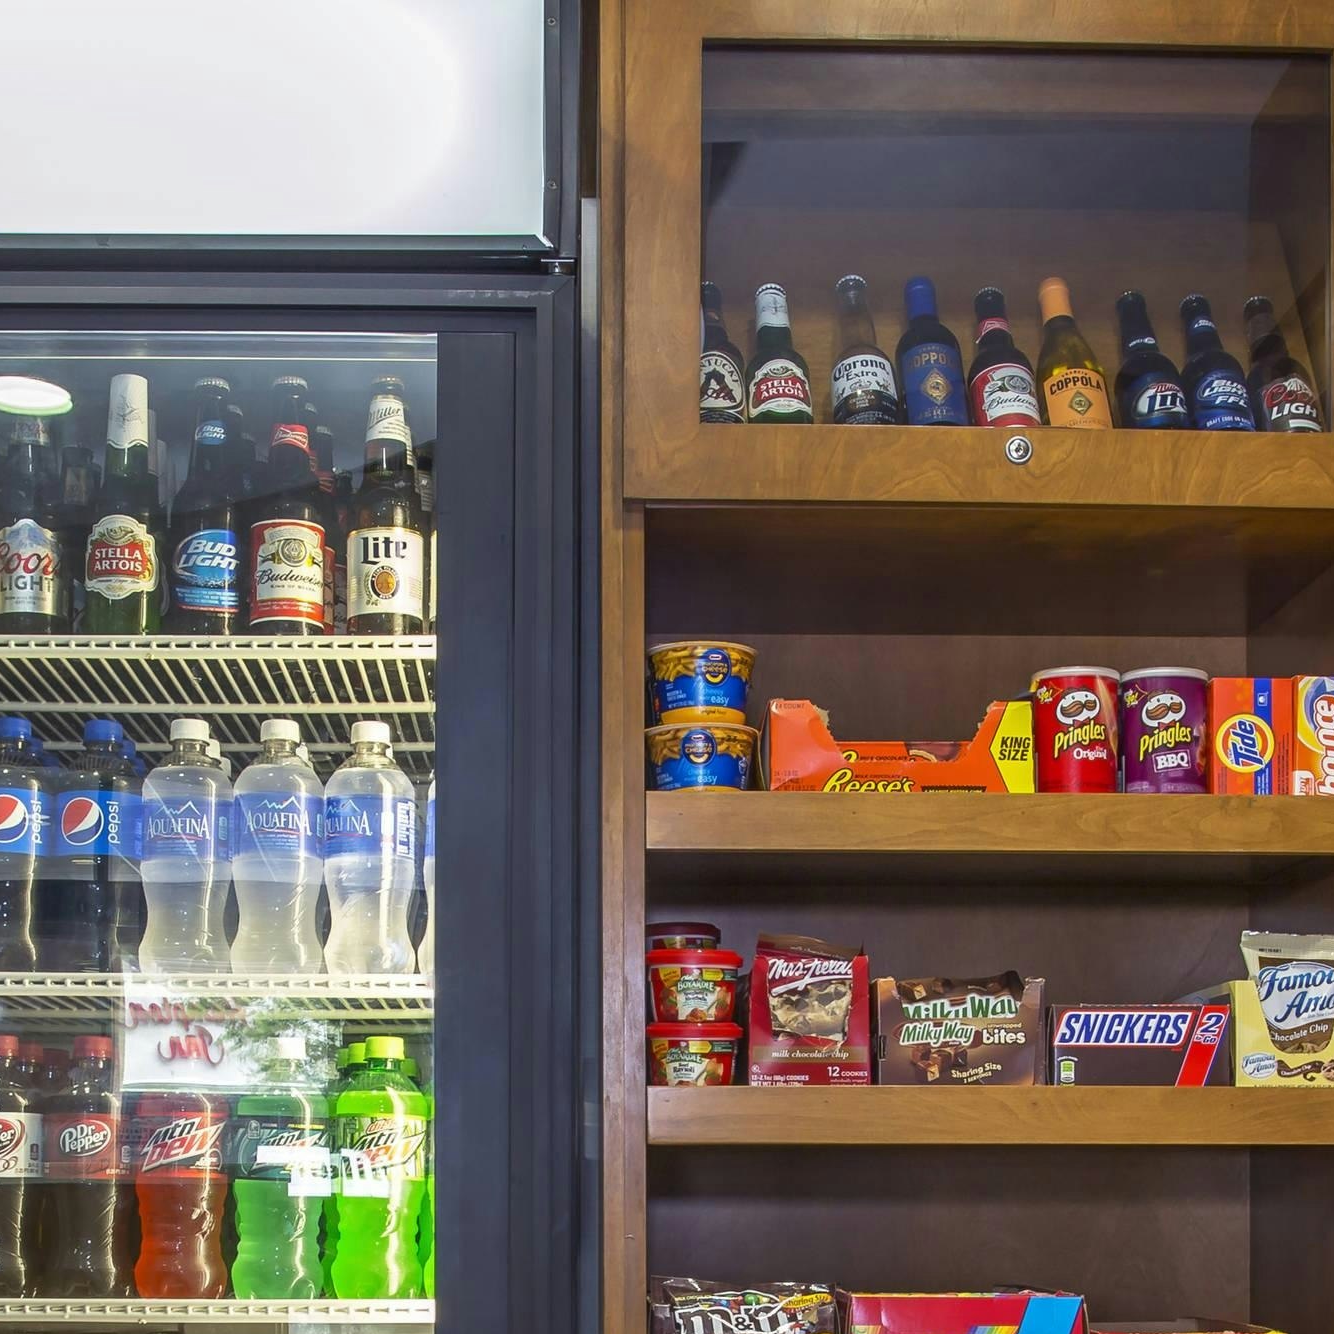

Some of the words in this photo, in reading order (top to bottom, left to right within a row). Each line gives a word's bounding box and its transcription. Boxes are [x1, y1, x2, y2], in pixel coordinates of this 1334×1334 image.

[833, 358, 886, 382] Corona
[760, 380, 802, 393] STELLA
[761, 386, 804, 400] ARTOIS
[1050, 376, 1102, 395] COPPOLA
[95, 546, 142, 560] STELLA
[187, 539, 237, 557] BUD
[360, 536, 408, 565] Lite
[94, 560, 143, 573] ARTOIS
[179, 554, 240, 570] LIGHT
[256, 570, 325, 587] Budweiser
[711, 696, 729, 706] easy
[1000, 737, 1031, 749] KING
[1054, 721, 1106, 758] Pringles
[1139, 725, 1191, 761] Pringles
[1231, 719, 1265, 767] Tide
[998, 750, 1029, 761] SIZE
[1155, 753, 1188, 769] BBQ
[30, 799, 42, 844] pepsi
[108, 800, 121, 844] pepsi
[147, 813, 211, 839] AQUAFINA
[244, 810, 313, 837] AQUAFINA
[1058, 1014, 1187, 1044] SNICKERS
[1199, 1013, 1225, 1035] 2
[1309, 1023, 1329, 1034] Chip
[901, 1022, 941, 1044] Milky
[943, 1022, 975, 1044] Way
[983, 1029, 1026, 1044] bites
[771, 1050, 790, 1058] milk
[828, 1067, 840, 1076] 12
[951, 1066, 983, 1078] Sharing
[985, 1062, 1002, 1071] Size
[77, 1124, 95, 1138] Dr
[64, 1128, 108, 1152] Pepper
